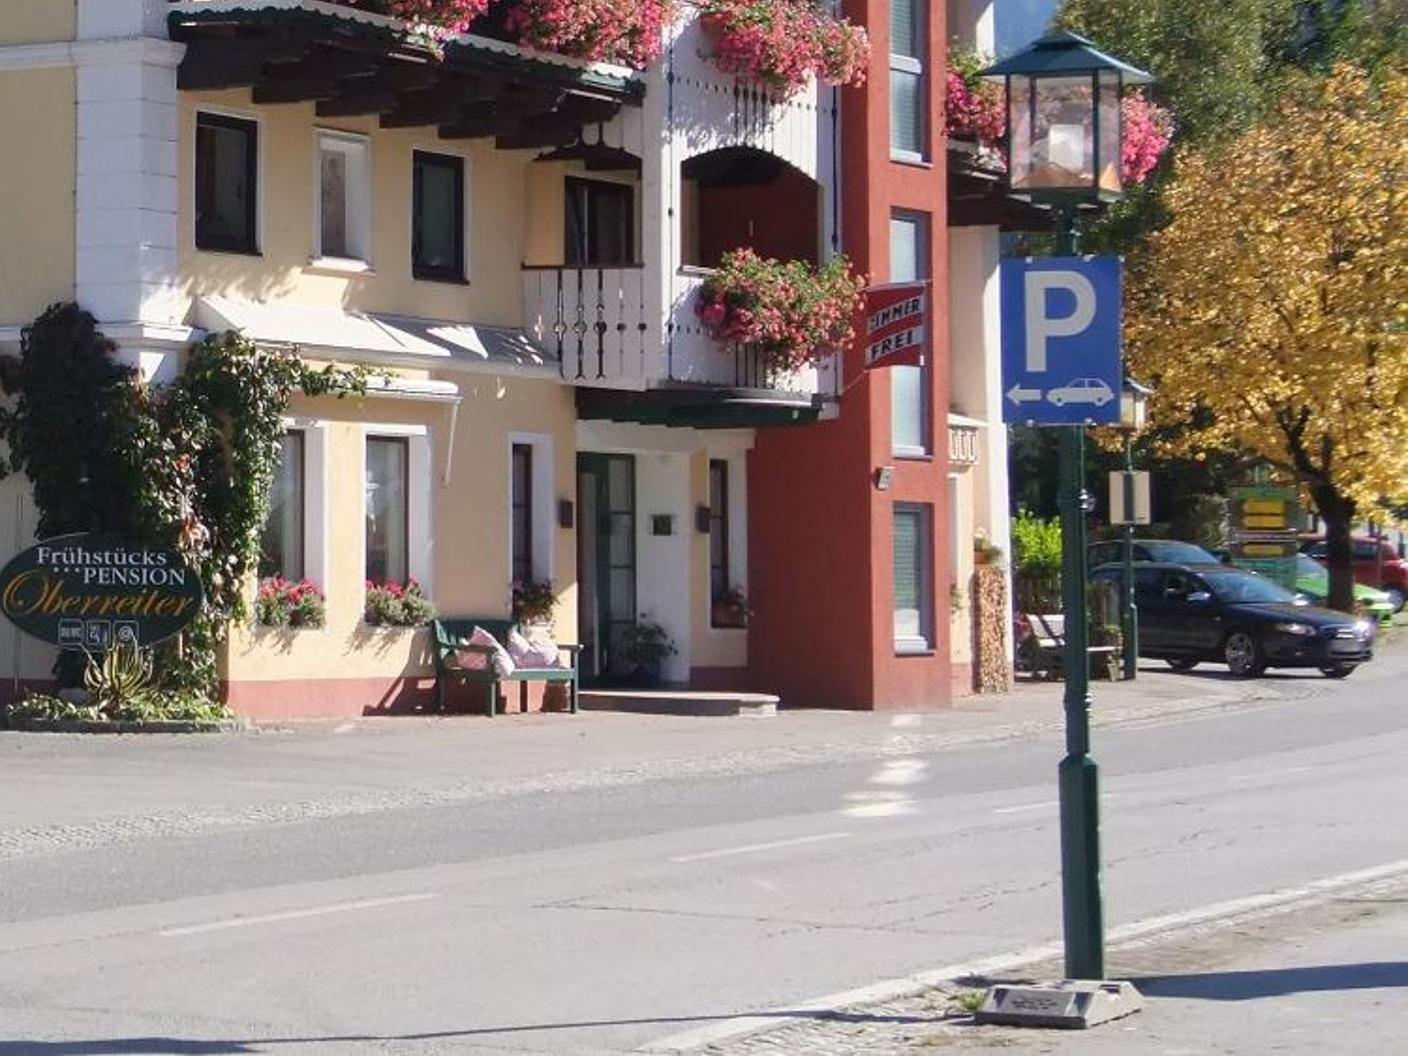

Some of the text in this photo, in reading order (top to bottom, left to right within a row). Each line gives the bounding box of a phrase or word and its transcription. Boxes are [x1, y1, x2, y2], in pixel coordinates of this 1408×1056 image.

[1024, 270, 1097, 372] P
[871, 330, 913, 359] FREI
[36, 546, 167, 566] Frühstücks
[83, 567, 185, 586] PENSION
[3, 568, 193, 616] Oberreiter
